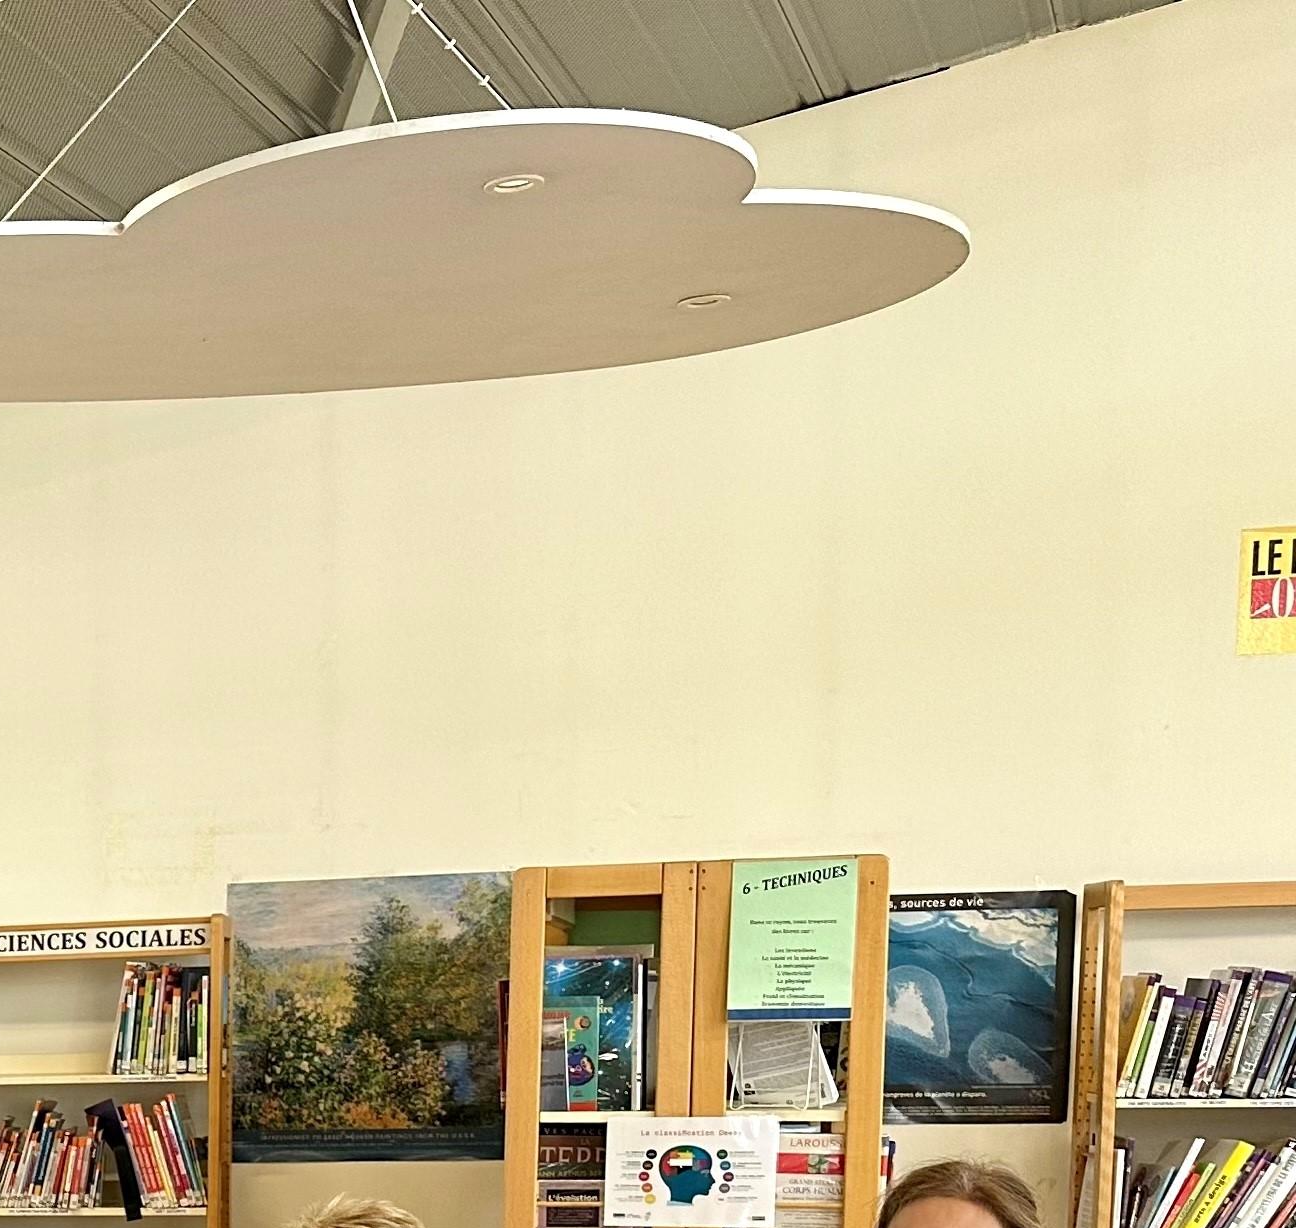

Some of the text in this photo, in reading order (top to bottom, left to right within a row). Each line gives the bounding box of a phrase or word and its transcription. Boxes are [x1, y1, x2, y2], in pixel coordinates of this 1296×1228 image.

[743, 883, 750, 894] 6
[762, 865, 847, 891] TECHNIQUES
[901, 899, 945, 908] sources
[949, 897, 963, 906] de
[967, 897, 984, 906] vie
[96, 928, 206, 949] SOCIALES
[548, 1193, 598, 1202] L'évolution
